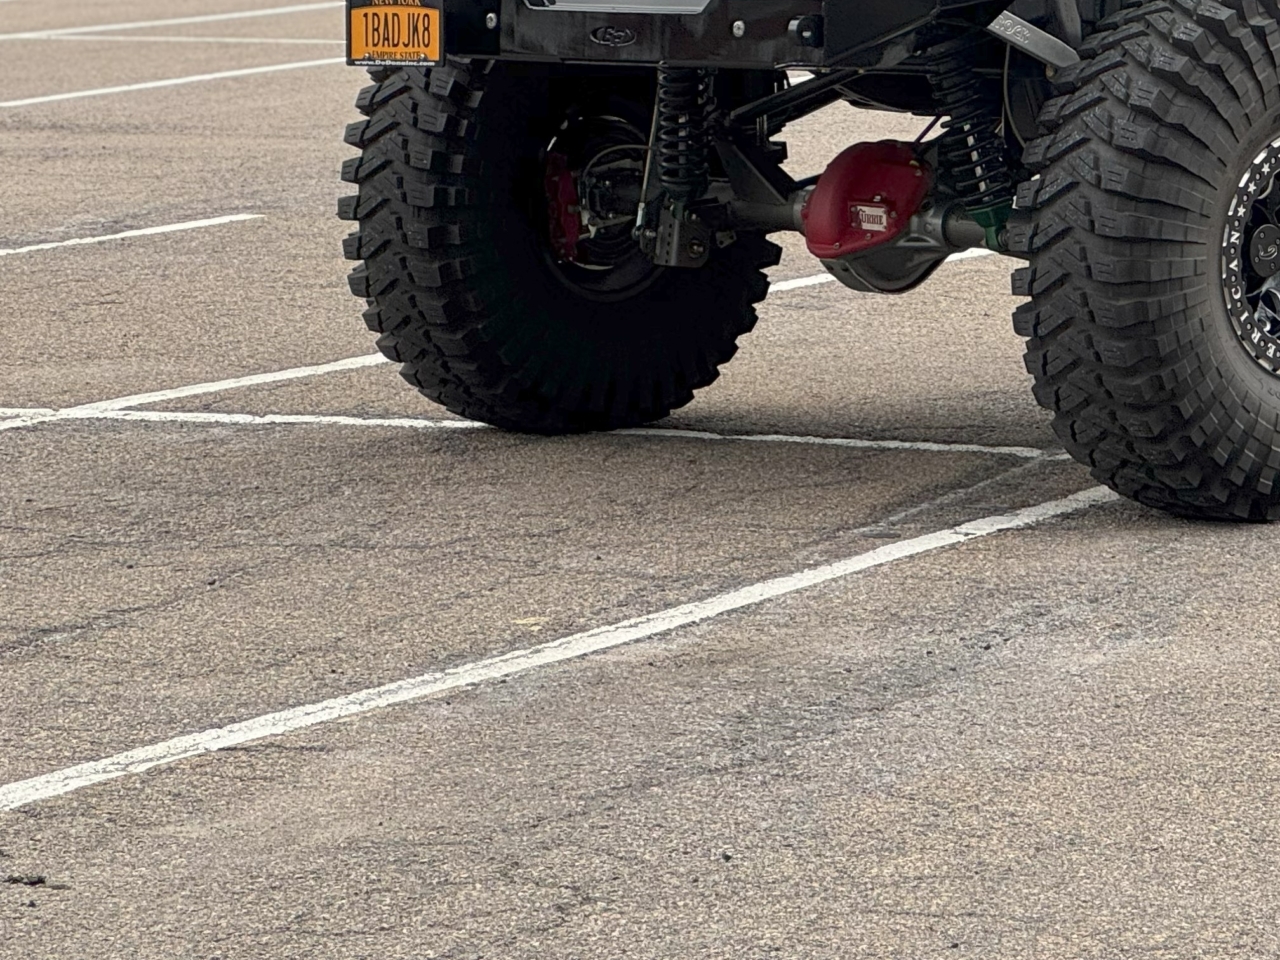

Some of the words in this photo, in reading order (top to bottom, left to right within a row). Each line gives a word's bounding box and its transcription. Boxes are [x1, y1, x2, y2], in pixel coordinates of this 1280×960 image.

[362, 12, 431, 49] 1BADJK8
[372, 50, 397, 59] EMPIRE
[400, 51, 421, 59] STATE
